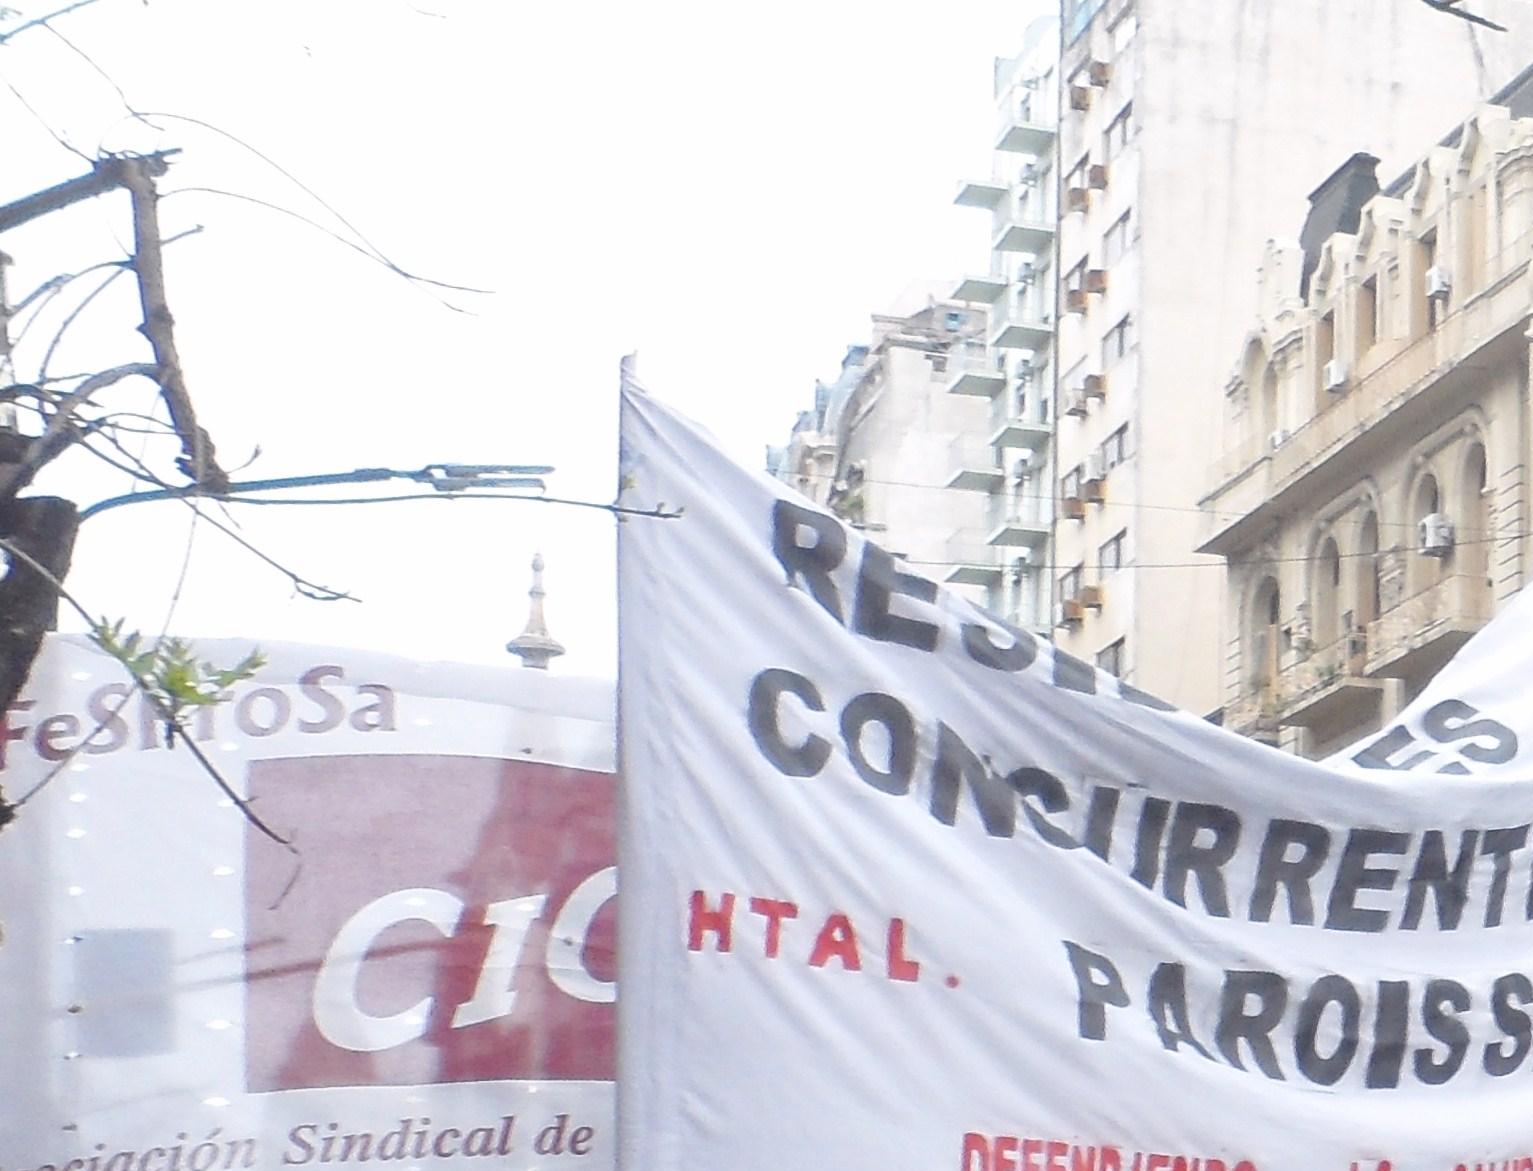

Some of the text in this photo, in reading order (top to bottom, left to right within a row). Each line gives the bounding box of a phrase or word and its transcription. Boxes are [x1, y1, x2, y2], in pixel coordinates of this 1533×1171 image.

[687, 889, 961, 990] HTAL.
[281, 1116, 516, 1168] Sindical
[533, 1112, 594, 1158] de
